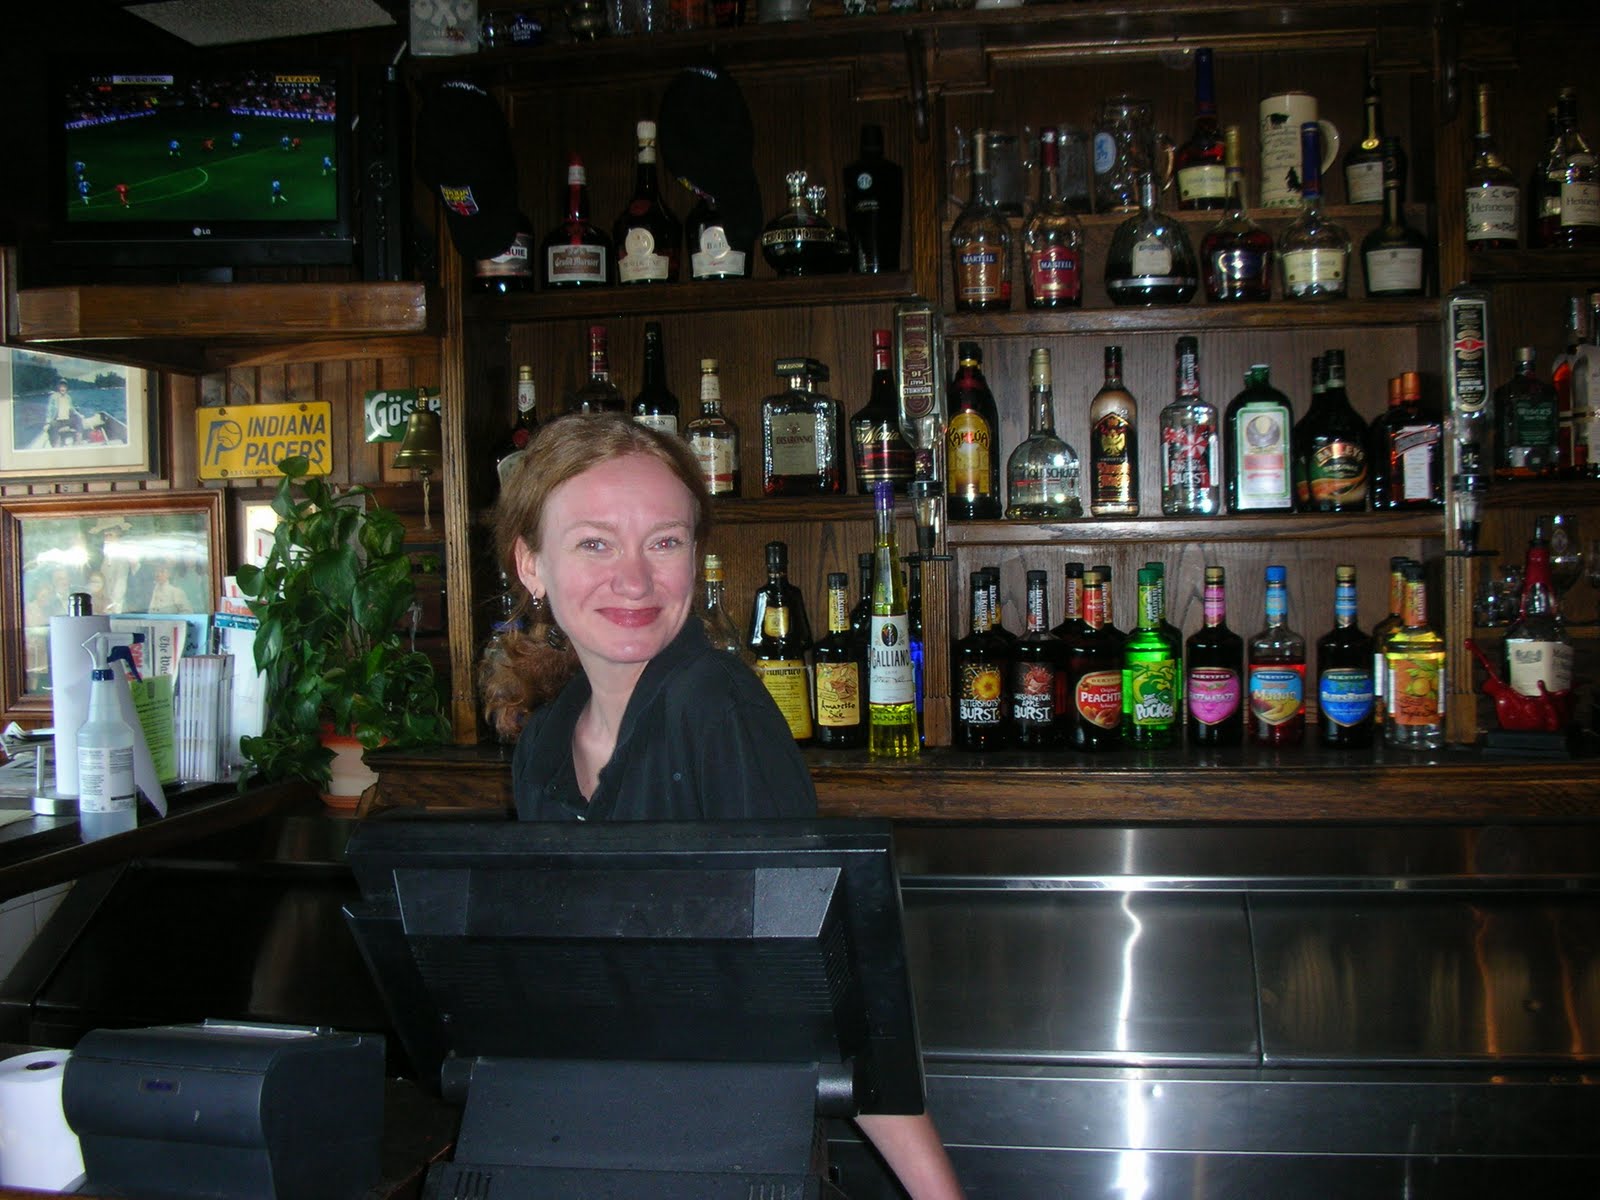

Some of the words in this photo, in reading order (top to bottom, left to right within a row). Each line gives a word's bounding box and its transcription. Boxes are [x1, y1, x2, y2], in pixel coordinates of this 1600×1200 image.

[962, 253, 995, 263] MARTELL
[246, 414, 326, 438] INDIANA
[243, 438, 326, 466] PACERS
[158, 635, 171, 653] The
[872, 648, 910, 669] GALLIANO
[1021, 700, 1041, 708] APPLE
[960, 706, 998, 721] BURST
[1014, 705, 1051, 720] BURST
